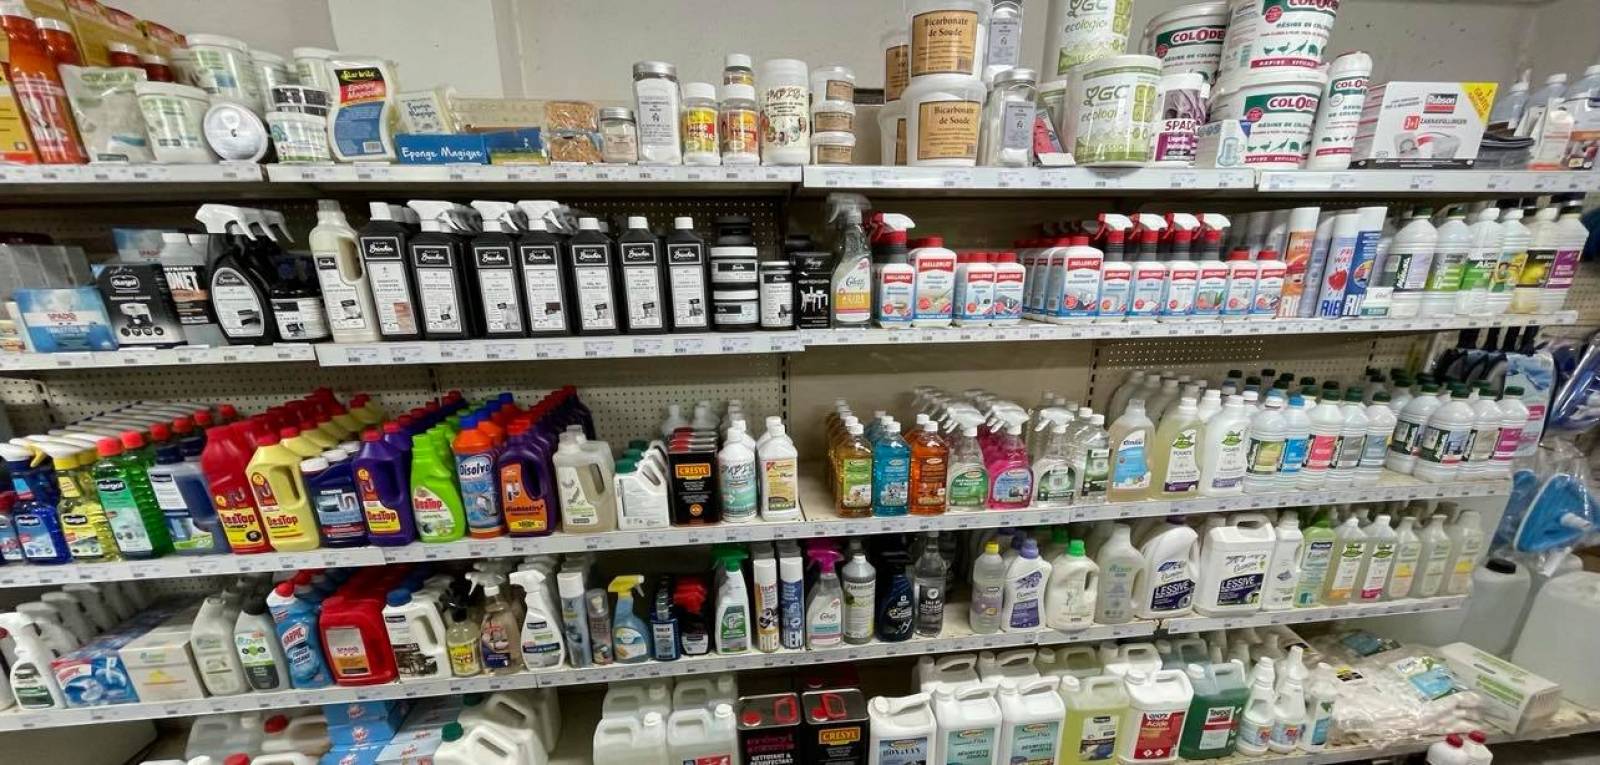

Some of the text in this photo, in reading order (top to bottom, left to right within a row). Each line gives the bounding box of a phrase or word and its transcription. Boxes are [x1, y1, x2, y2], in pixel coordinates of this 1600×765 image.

[924, 16, 969, 27] Bicarbonate
[928, 28, 963, 37] de Soude
[1427, 95, 1456, 105] Rubson
[938, 116, 970, 125] de Soude
[402, 146, 483, 161] Eponge Magique
[680, 466, 709, 474] CRESYL
[221, 513, 255, 525] DesTop
[266, 514, 298, 526] DesTop
[367, 510, 396, 522] DesTop
[1155, 580, 1190, 596] LESSIVE
[1223, 575, 1256, 590] LESSIVE
[823, 731, 856, 740] CRESYL
